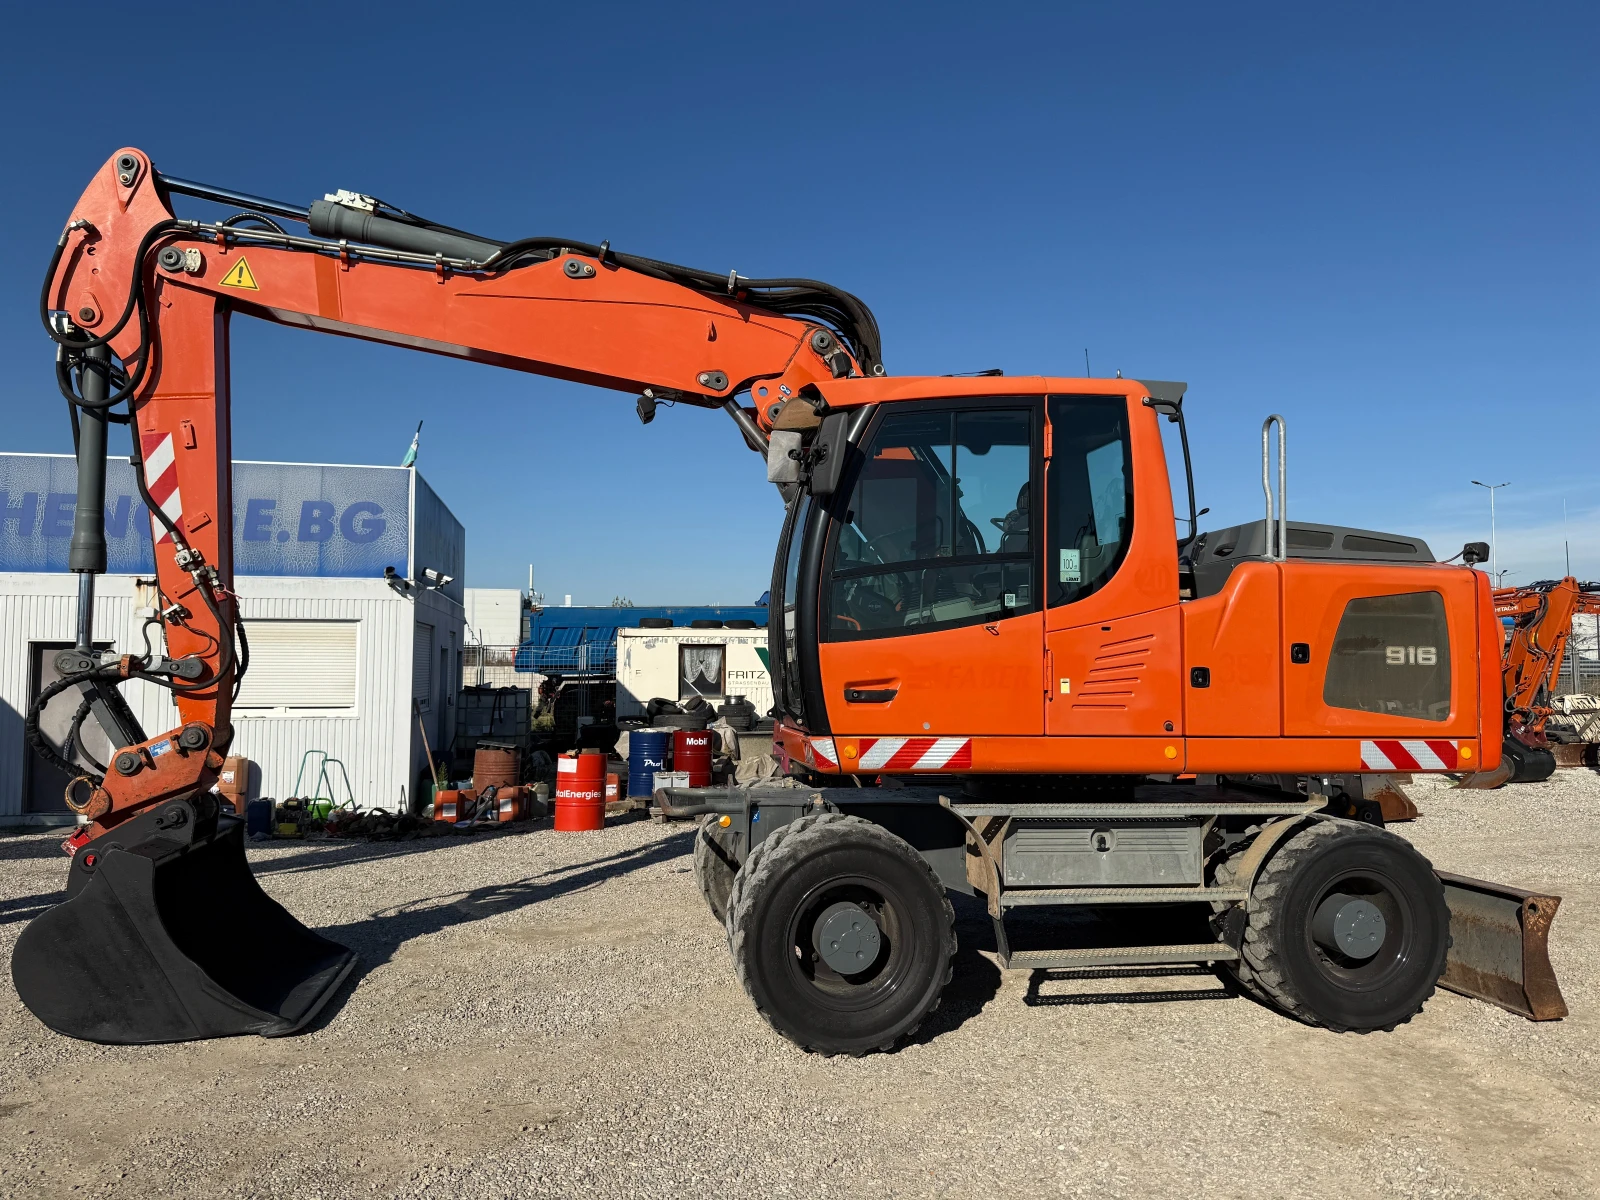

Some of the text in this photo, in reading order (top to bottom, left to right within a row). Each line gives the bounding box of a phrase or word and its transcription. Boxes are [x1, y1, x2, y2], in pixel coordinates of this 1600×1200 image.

[1385, 645, 1437, 666] 916
[728, 670, 766, 680] FRITZ
[686, 737, 708, 746] Mobil
[556, 788, 602, 800] talEnergies
